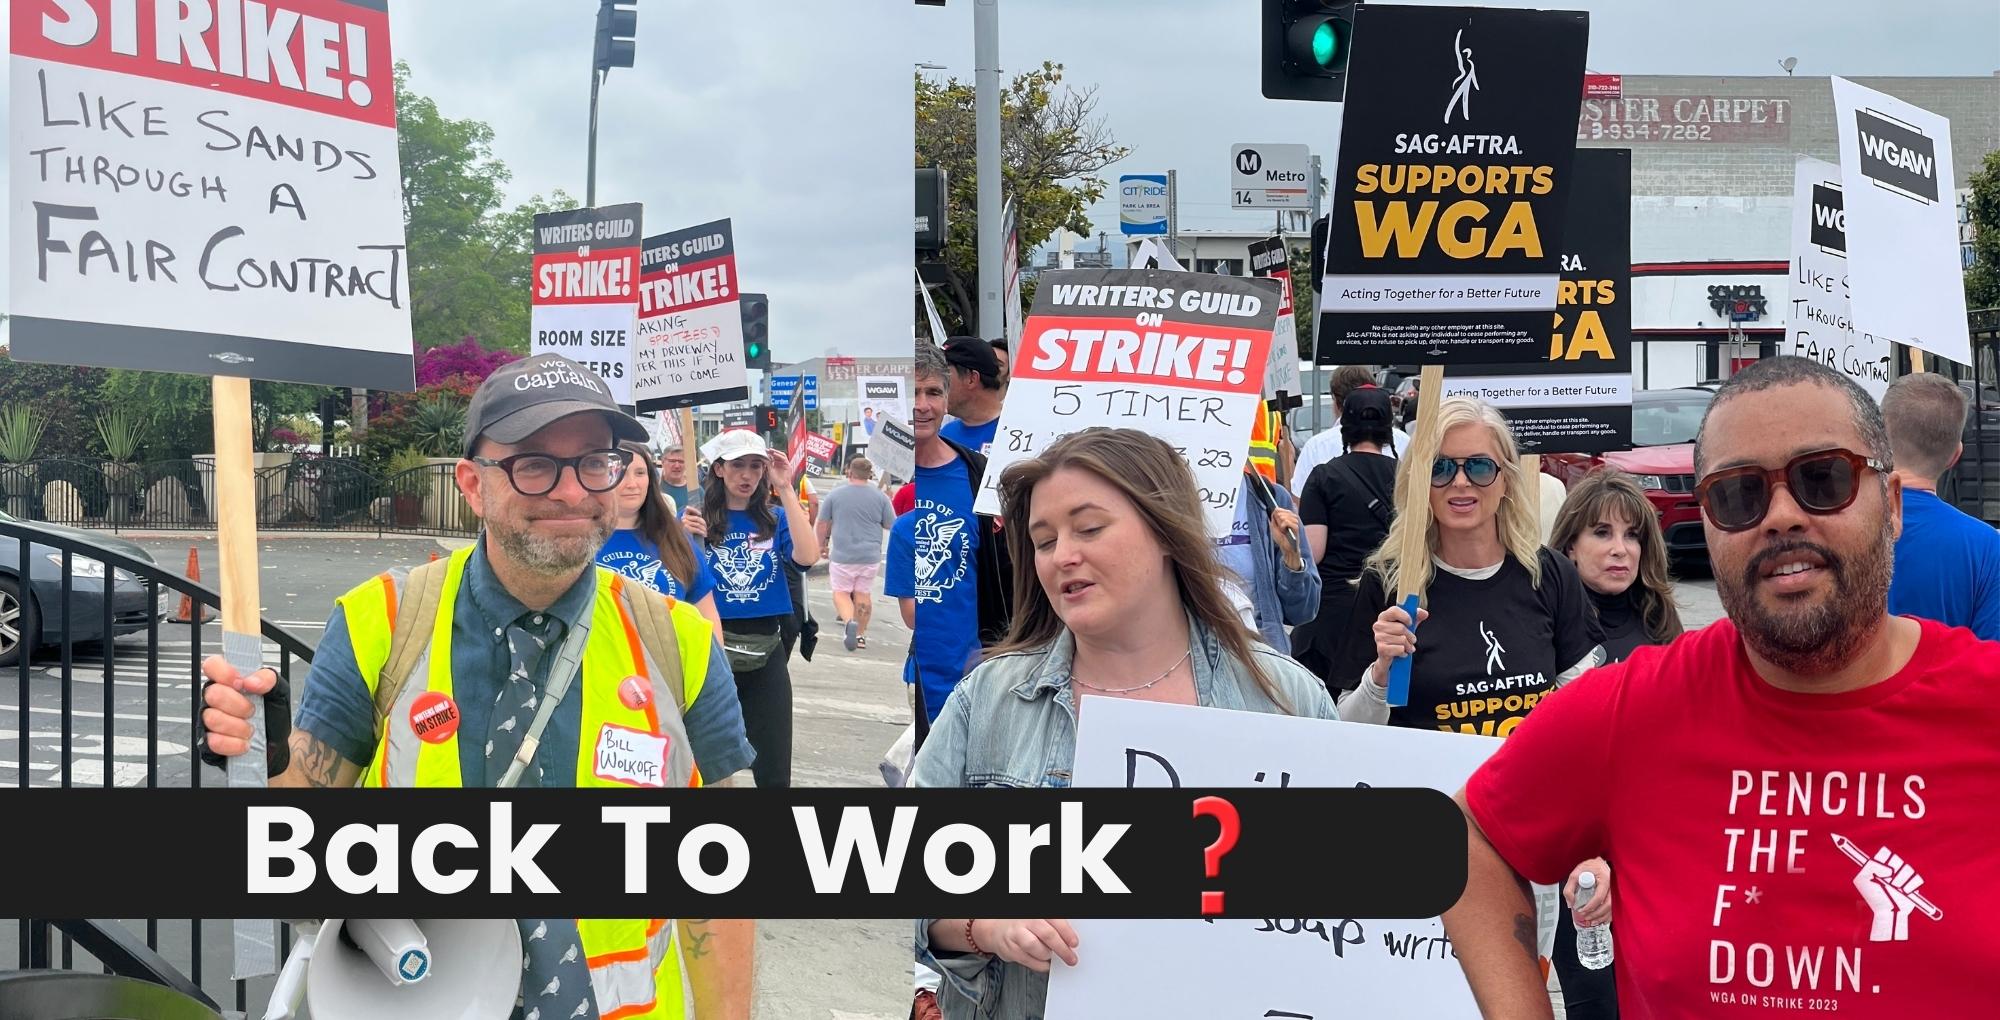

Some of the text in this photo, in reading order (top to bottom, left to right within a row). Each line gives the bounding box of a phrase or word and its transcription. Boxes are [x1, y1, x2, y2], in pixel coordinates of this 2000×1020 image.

[42, 0, 373, 107] STRIKE!
[38, 68, 376, 179] LIKE SANDS
[1581, 98, 1792, 123] STER CARPET
[1861, 131, 1932, 179] WGAW
[30, 147, 307, 221] THROUGH A
[1266, 170, 1305, 182] Metro
[1355, 164, 1554, 195] SUPPORTS
[1236, 191, 1252, 205] 14
[1354, 200, 1544, 259] WGA
[1815, 204, 1845, 231] WG
[540, 219, 634, 245] WRITERS GUILD
[32, 201, 405, 309] FAIR CONTRACT
[578, 246, 589, 257] ON
[641, 233, 725, 266] ITERS GUILD
[539, 257, 631, 298] STRIKE!
[665, 262, 678, 274] ON
[1798, 256, 1835, 293] LIKE
[640, 264, 729, 312] TRIKE!
[1052, 284, 1174, 309] WRITERS
[1180, 293, 1261, 317] GUILD
[1341, 288, 1541, 301] Acting Together for a Better Future
[638, 315, 687, 335] AKING
[1136, 312, 1163, 327] ON
[1793, 299, 1855, 334] THROUGH
[539, 330, 626, 346] ROOM SIZE
[639, 340, 717, 359] MY DRIVEWAY
[709, 353, 734, 366] YOU
[1031, 329, 1251, 385] STRIKE!
[514, 368, 602, 394] Captain
[690, 368, 720, 381] COME
[1053, 385, 1231, 427] 5 TIMER
[1447, 388, 1478, 399] Acting
[1482, 386, 1525, 399] Together
[1528, 387, 1541, 396] for
[1552, 386, 1582, 396] Better
[1585, 386, 1617, 395] Future
[768, 411, 775, 426] 5
[937, 504, 954, 517] OF
[1199, 488, 1236, 509] OLD!
[602, 551, 651, 563] GUILD OF
[661, 569, 676, 596] AMER
[415, 707, 457, 735] ON STRIKE
[1728, 769, 1926, 820] PENCILS
[1724, 828, 1808, 874] THE
[1384, 922, 1458, 960] writ
[1709, 939, 1880, 994] DOWN.
[1710, 991, 1838, 1012] WGA ON STRIKE 2023
